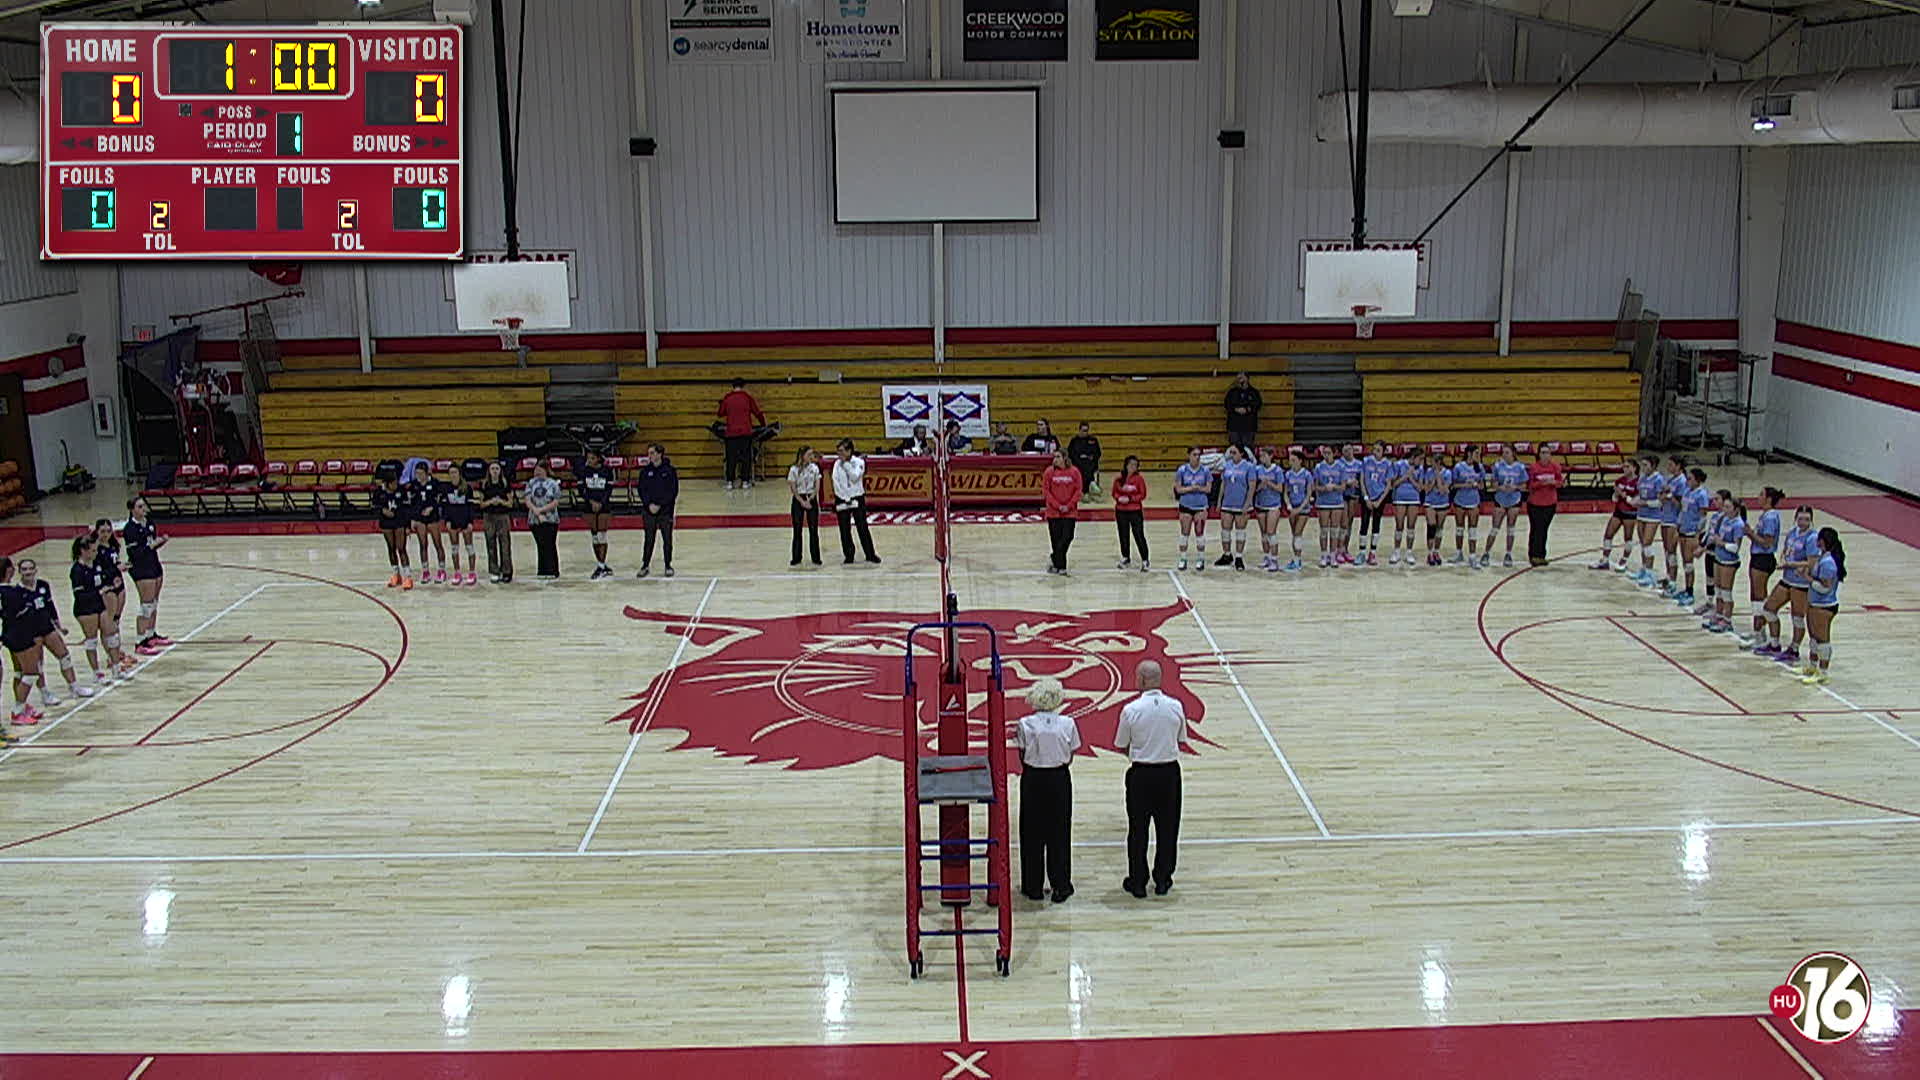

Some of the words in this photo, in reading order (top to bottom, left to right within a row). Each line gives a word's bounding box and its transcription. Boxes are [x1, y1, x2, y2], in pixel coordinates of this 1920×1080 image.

[806, 21, 900, 36] Hometown
[966, 12, 1065, 30] CREEKWOOD
[1010, 31, 1065, 39] COMPANY
[1099, 29, 1195, 41] STALLION
[863, 475, 924, 491] RDING
[950, 472, 1044, 489] WILDCAT
